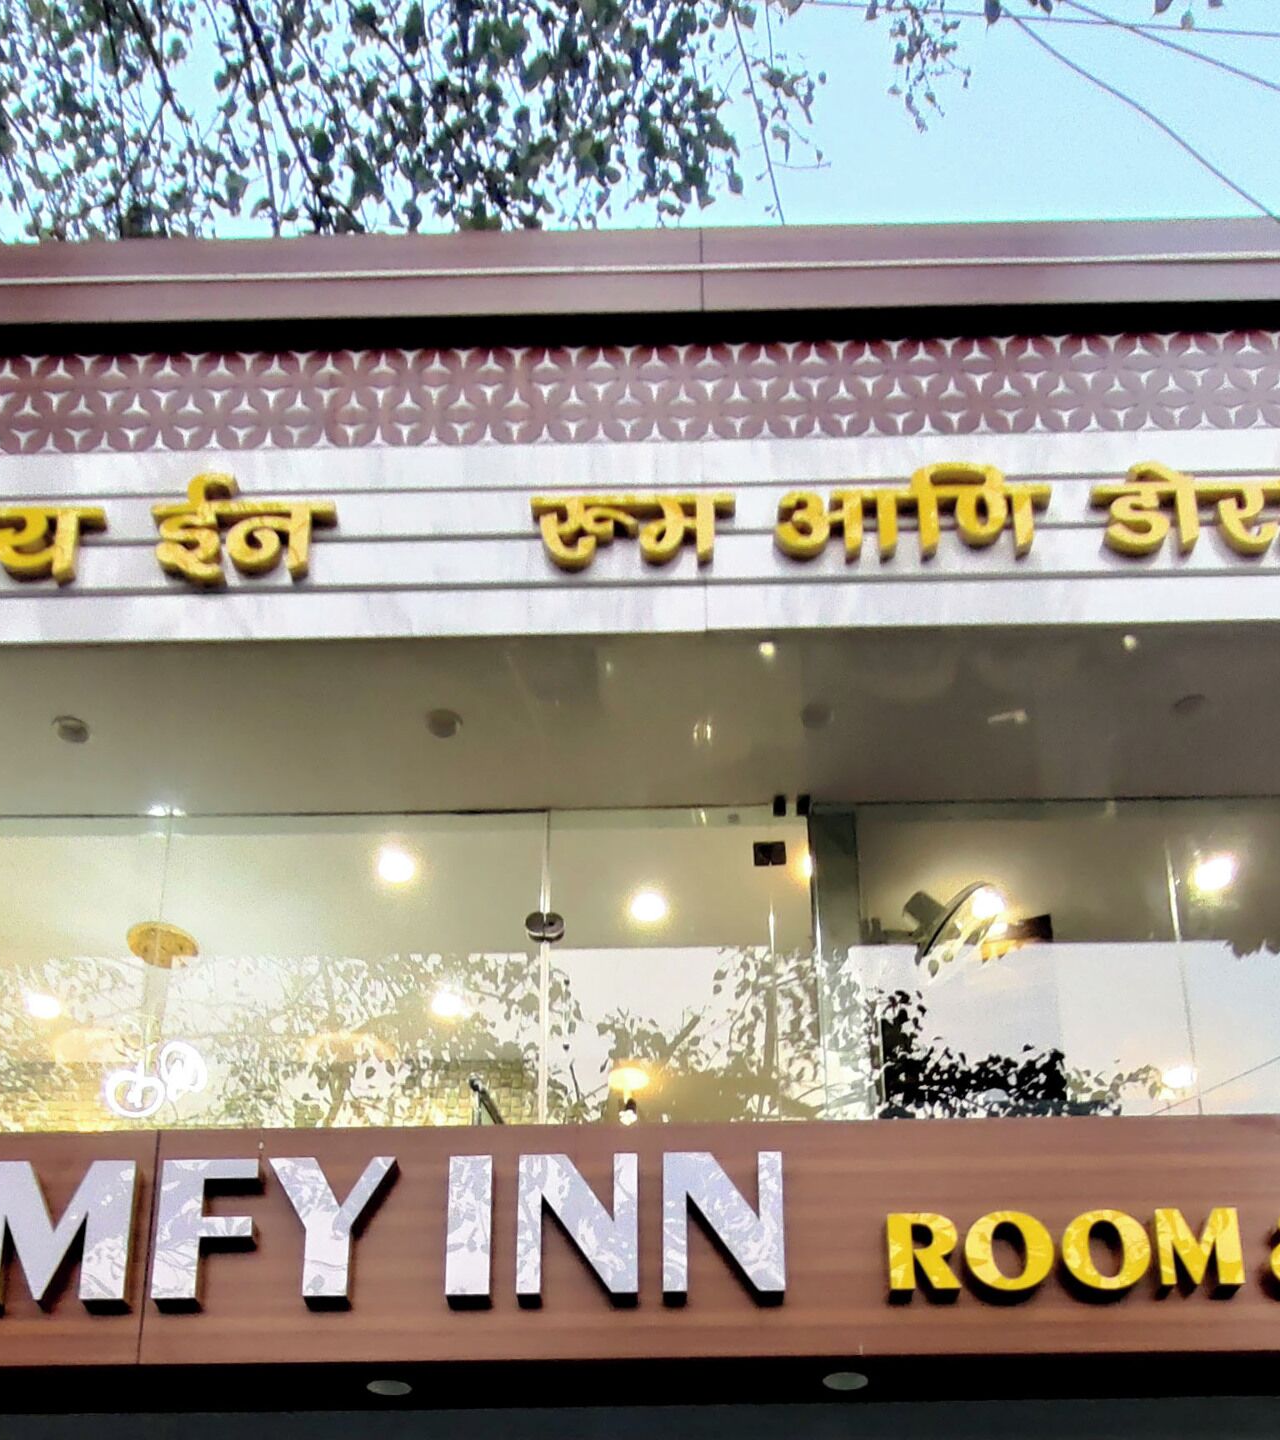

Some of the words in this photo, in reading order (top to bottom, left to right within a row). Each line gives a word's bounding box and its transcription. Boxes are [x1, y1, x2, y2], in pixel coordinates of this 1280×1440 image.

[151, 472, 338, 586] ईन
[531, 490, 735, 573] रूम
[773, 461, 1051, 561] आणि
[442, 1150, 788, 1312] INN
[885, 1207, 1247, 1304] ROOM
